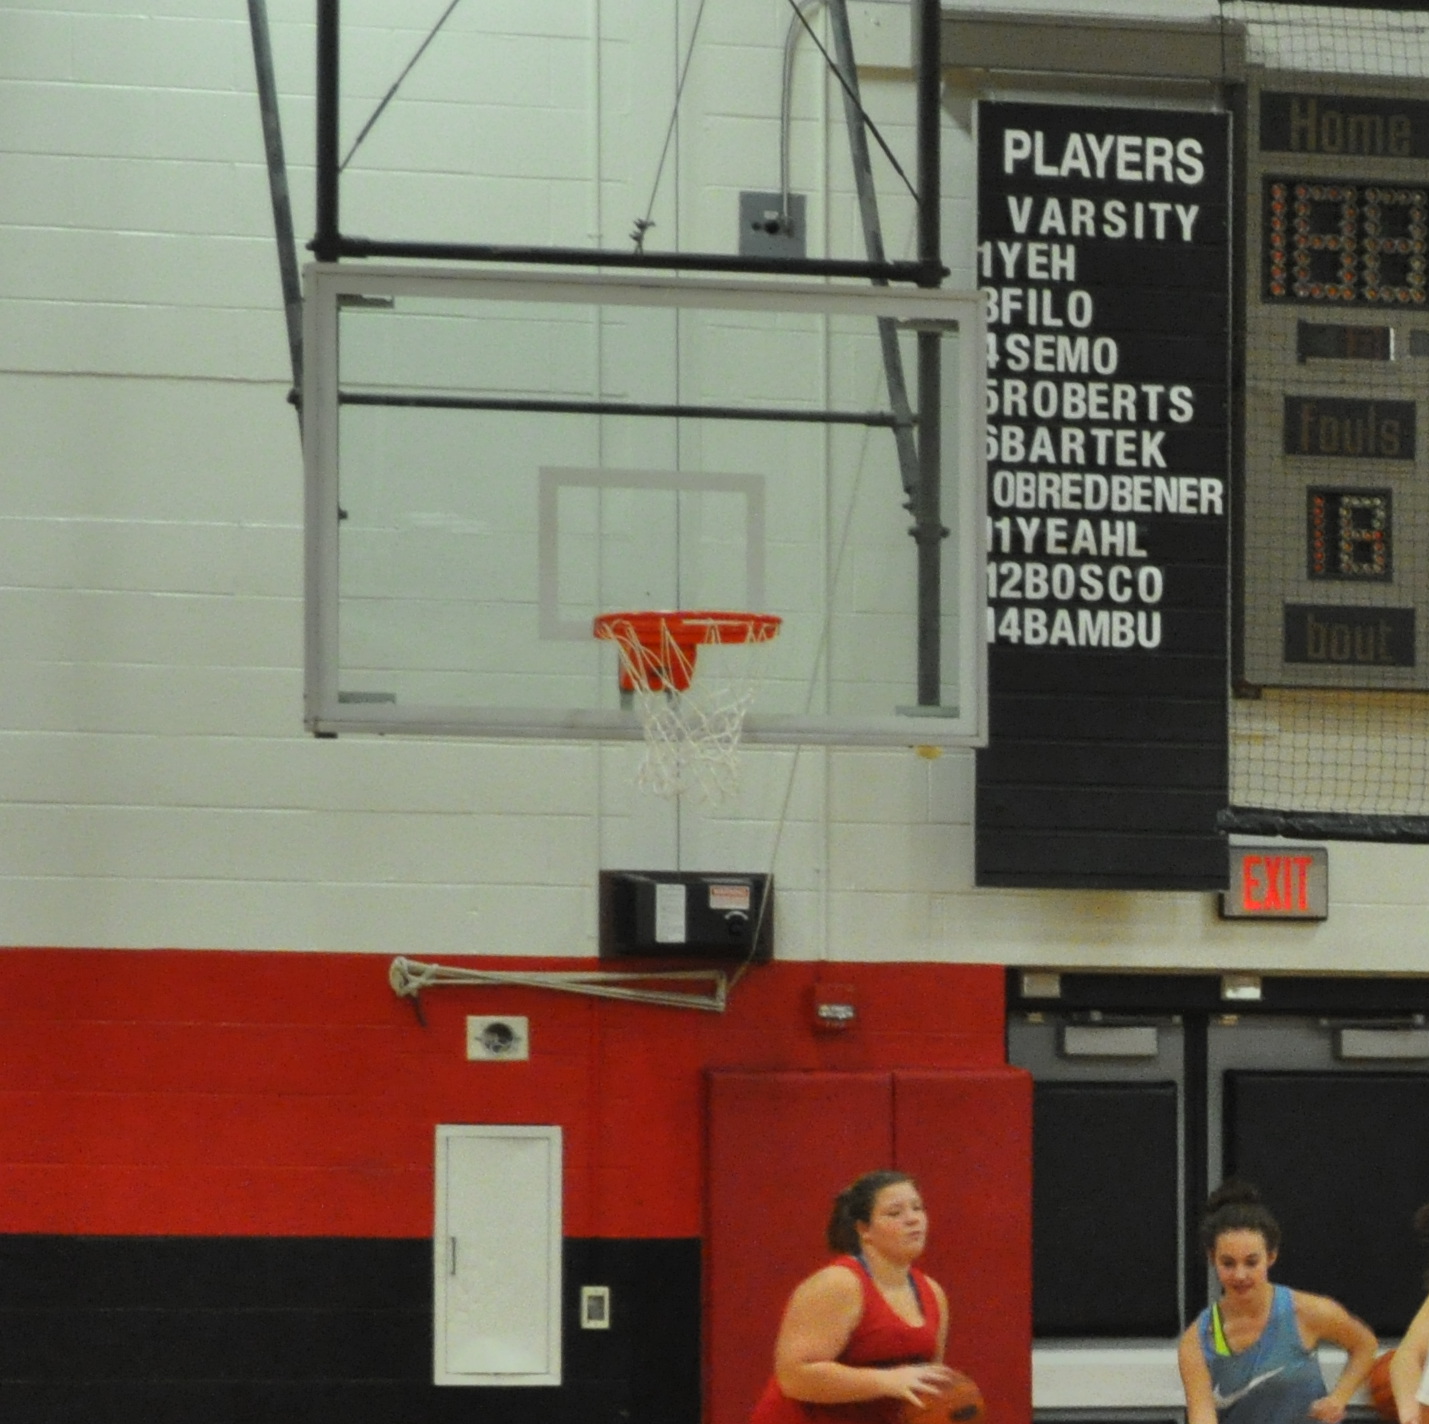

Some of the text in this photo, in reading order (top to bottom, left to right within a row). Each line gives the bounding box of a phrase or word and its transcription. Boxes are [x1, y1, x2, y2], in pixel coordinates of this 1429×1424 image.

[1290, 105, 1412, 155] Home
[1003, 128, 1204, 184] PLAYERS
[1007, 195, 1200, 242] VARSITY
[1301, 402, 1400, 454] fouls
[1306, 611, 1395, 662] bout
[1242, 855, 1313, 912] EXIT
